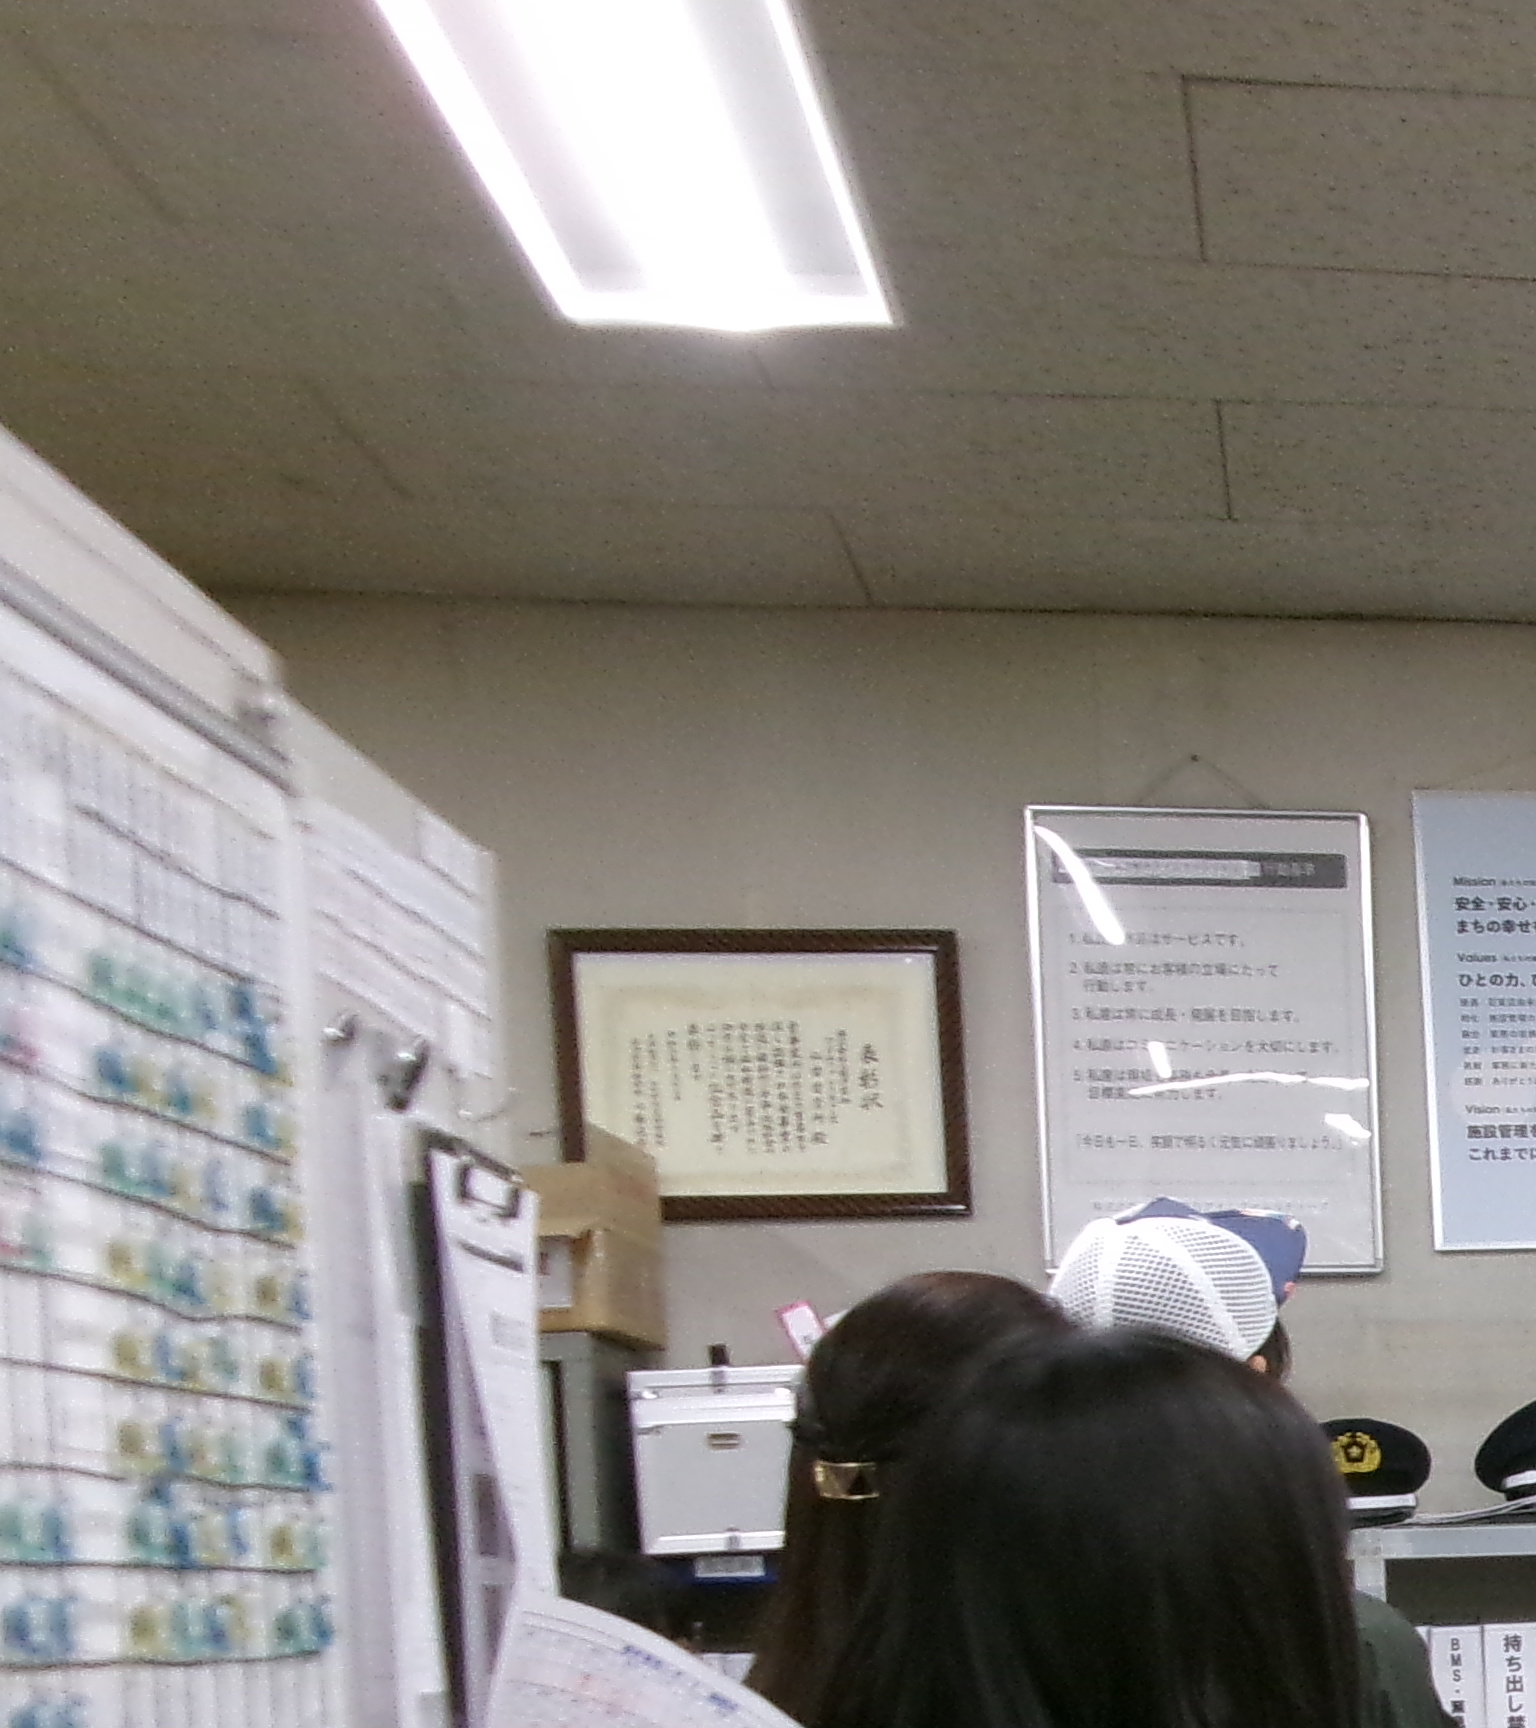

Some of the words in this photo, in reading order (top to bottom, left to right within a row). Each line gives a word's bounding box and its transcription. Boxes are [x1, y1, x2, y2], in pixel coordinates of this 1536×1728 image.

[1452, 876, 1497, 887] Mission
[1456, 952, 1498, 963] Values
[1465, 1104, 1500, 1114] Vision
